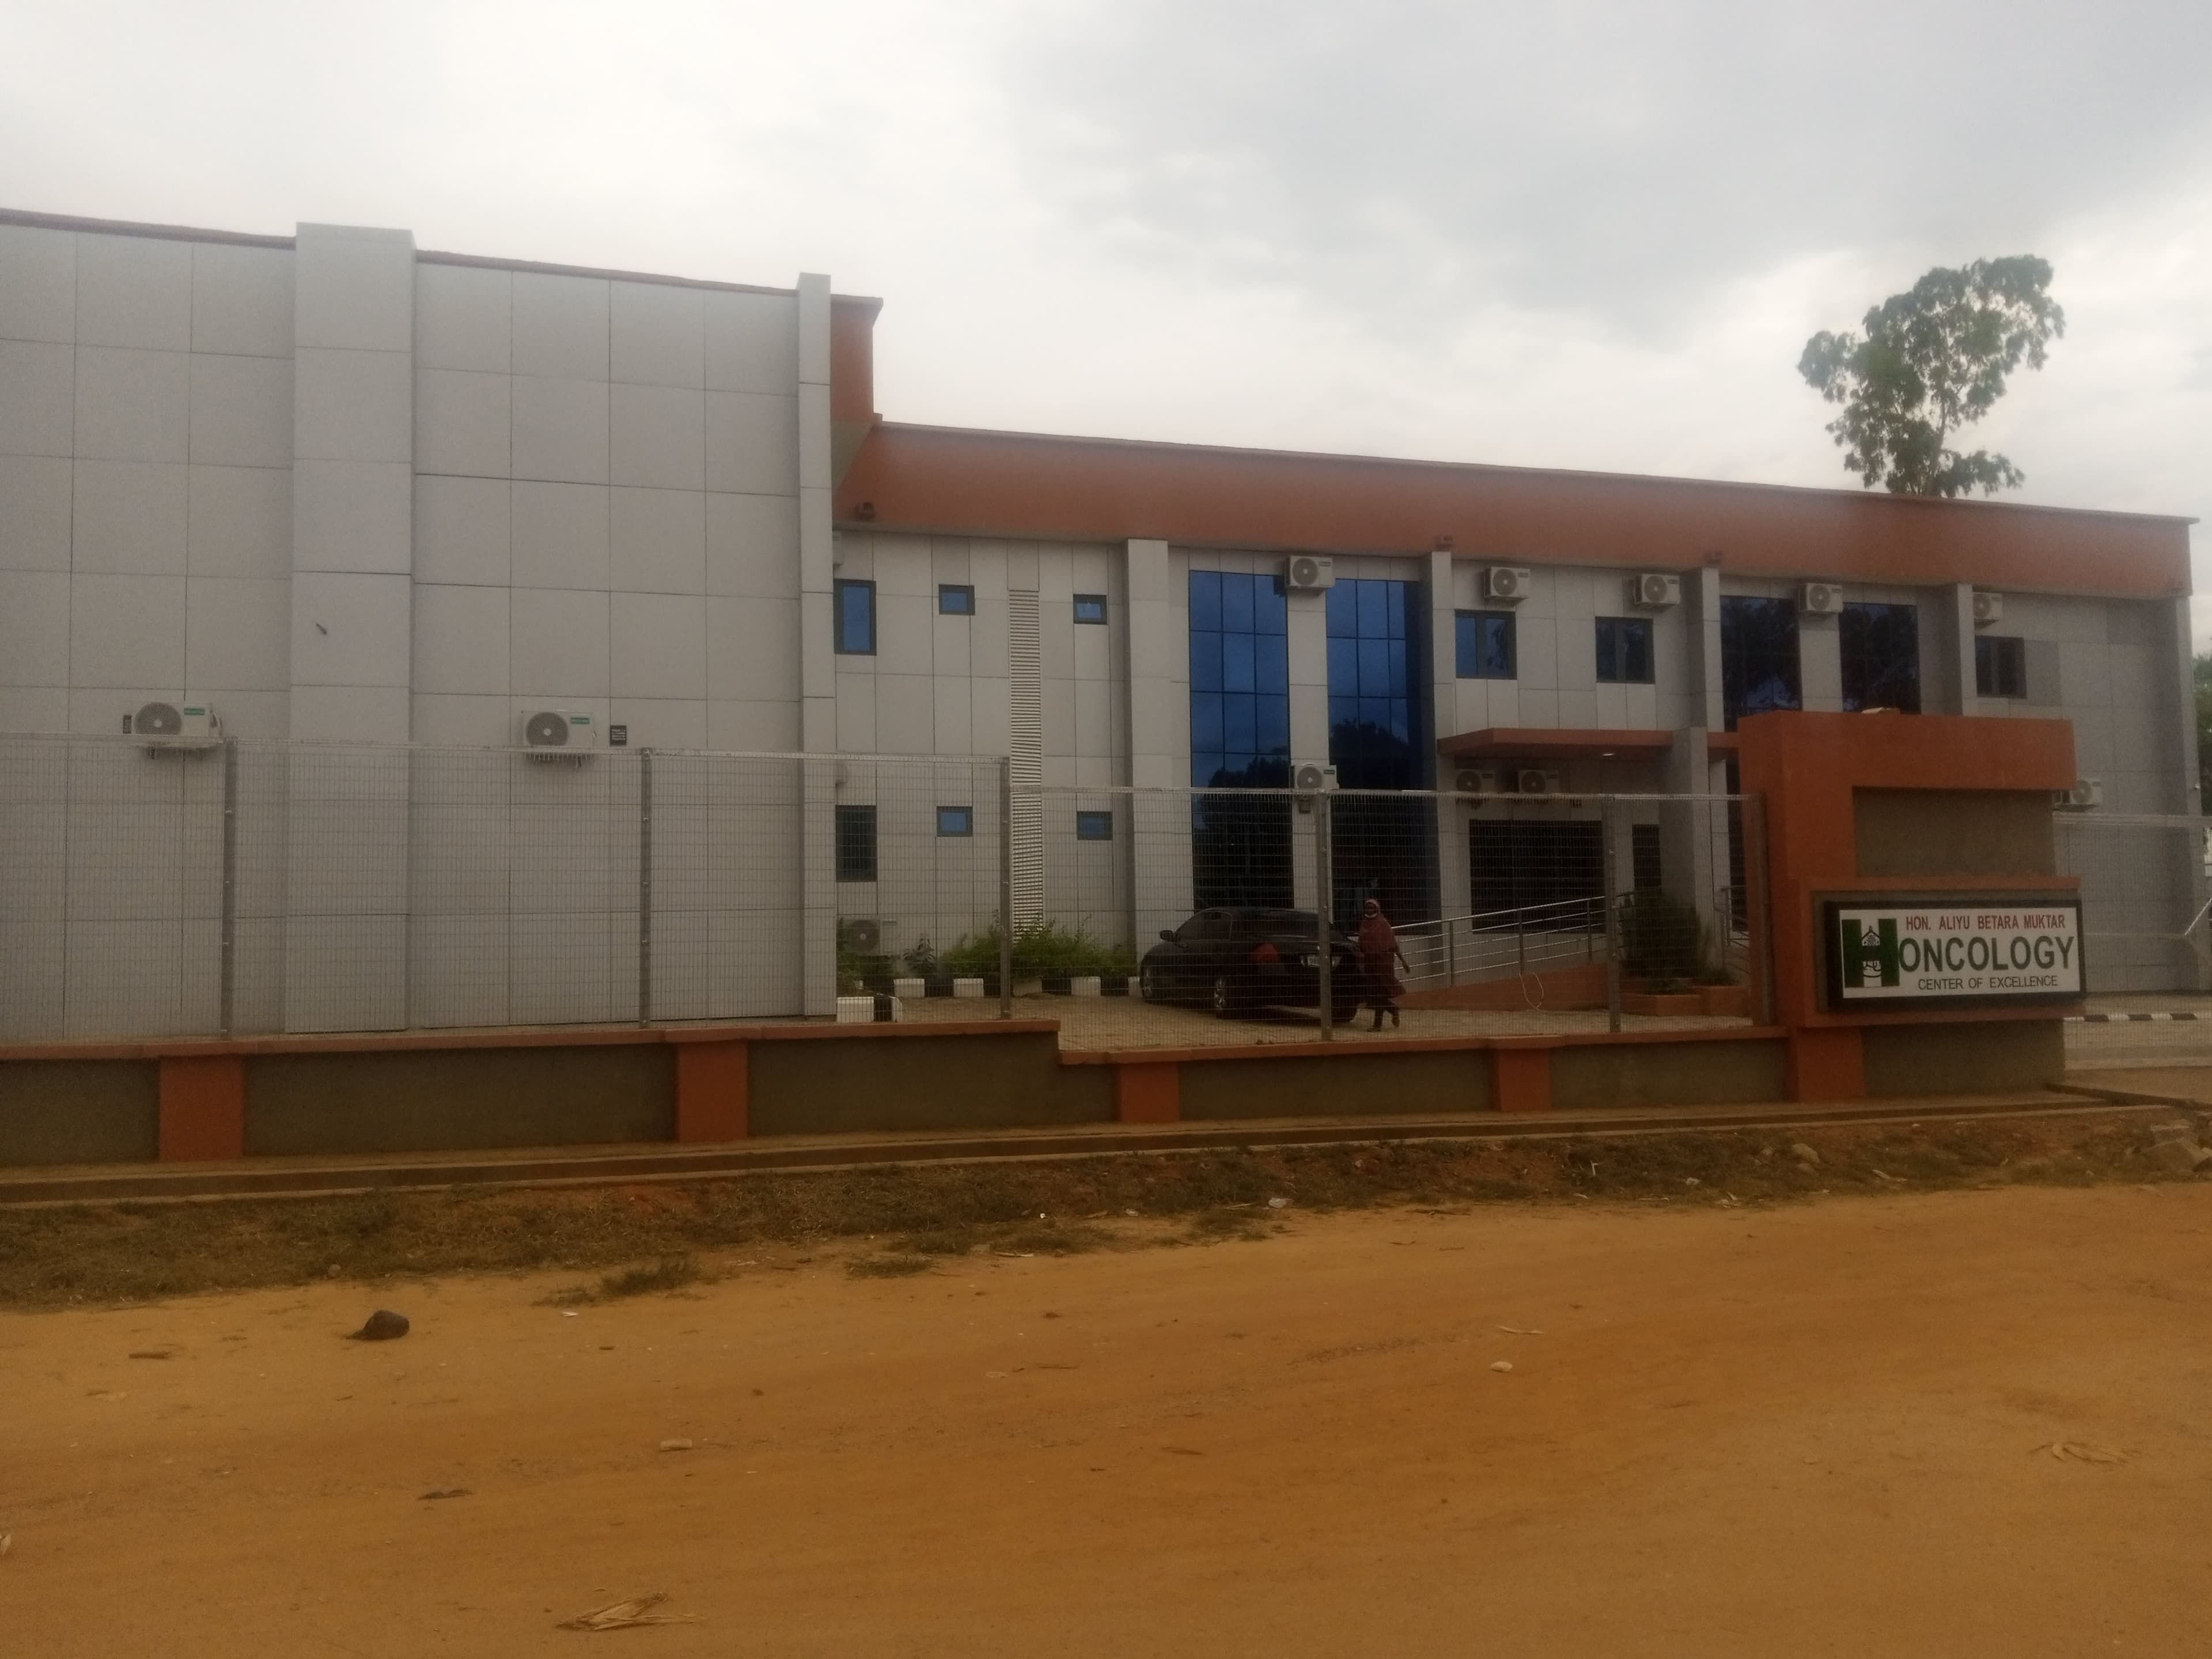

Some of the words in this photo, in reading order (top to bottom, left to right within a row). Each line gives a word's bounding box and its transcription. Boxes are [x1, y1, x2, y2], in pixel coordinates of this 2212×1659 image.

[1906, 916, 1931, 931] HON.
[1939, 915, 1970, 930] ALIYU
[1978, 915, 2019, 930] BETARA
[2024, 914, 2066, 929] MUKTAR
[1899, 935, 2074, 972] ONCOLOGY
[1918, 978, 1964, 990] CENTER
[1968, 978, 1983, 988] OF
[1990, 975, 2059, 988] EXCELLENCE
